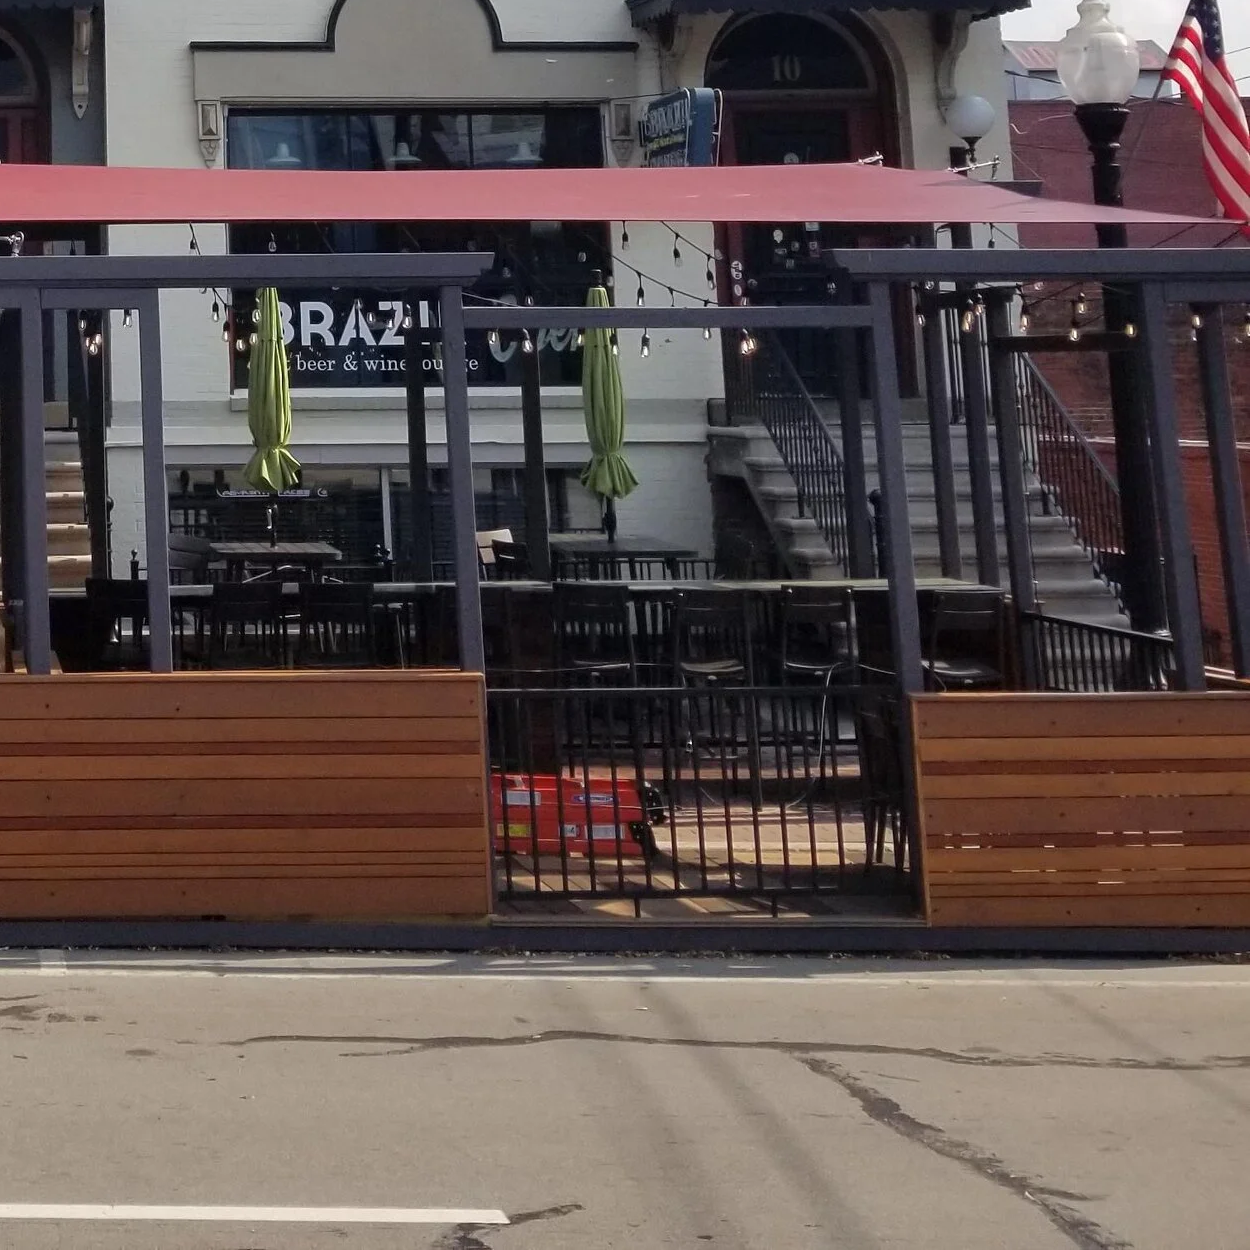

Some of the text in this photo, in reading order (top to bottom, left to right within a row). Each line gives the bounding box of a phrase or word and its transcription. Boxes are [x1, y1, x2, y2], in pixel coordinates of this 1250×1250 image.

[771, 54, 801, 82] 10
[278, 300, 467, 347] BRAZI
[296, 354, 336, 371] beer
[342, 353, 359, 371] &
[363, 354, 407, 371] wine
